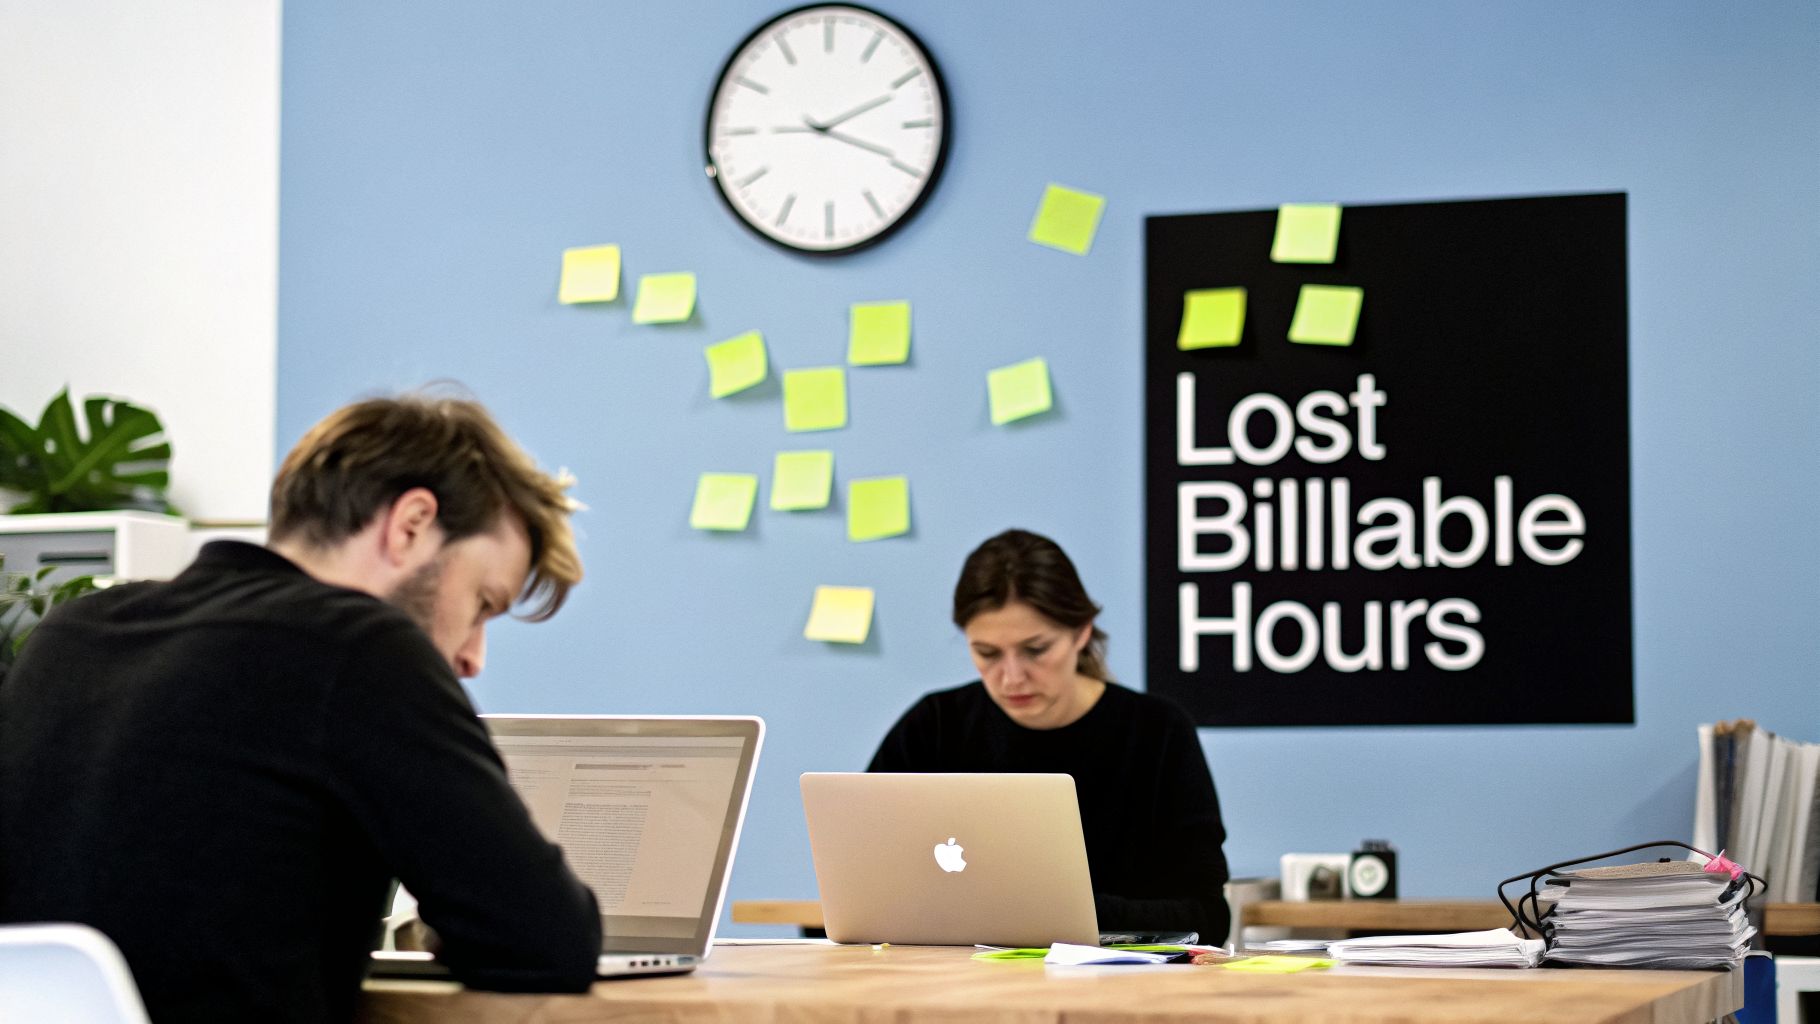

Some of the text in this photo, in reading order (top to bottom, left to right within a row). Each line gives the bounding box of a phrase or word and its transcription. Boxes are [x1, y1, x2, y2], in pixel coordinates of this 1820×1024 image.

[1176, 372, 1387, 466] Lost
[1177, 475, 1586, 572] Billlable
[1178, 581, 1485, 673] Hours
